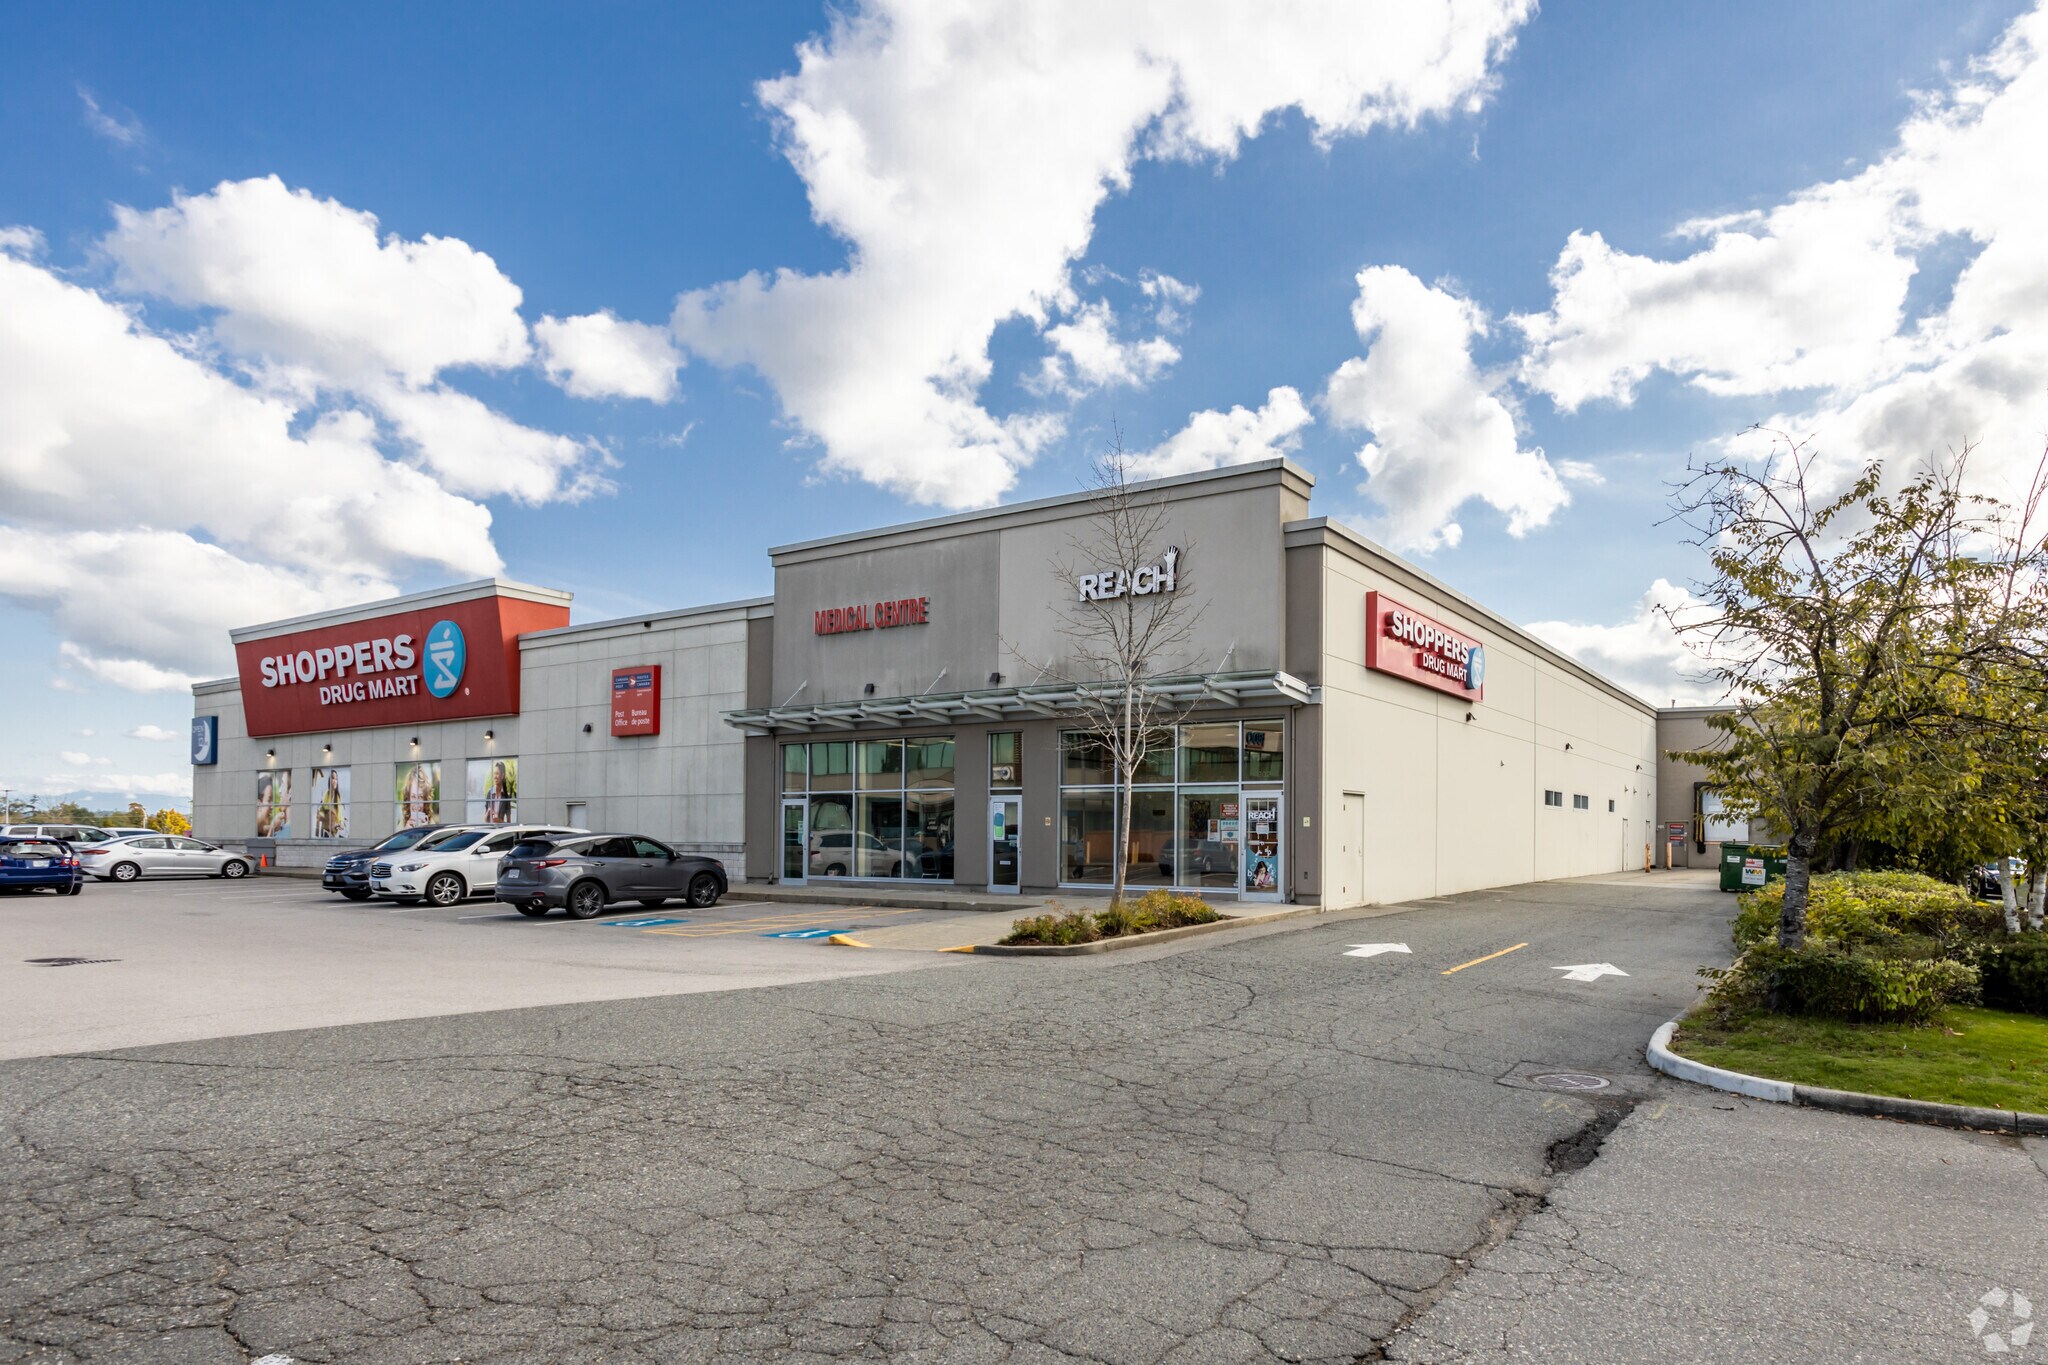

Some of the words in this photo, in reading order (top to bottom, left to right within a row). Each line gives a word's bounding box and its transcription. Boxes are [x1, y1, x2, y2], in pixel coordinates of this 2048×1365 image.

[1079, 546, 1176, 602] REACH
[814, 604, 870, 635] MEDICAL
[874, 596, 930, 630] CENTRE
[1391, 610, 1469, 665] SHOPPERS
[260, 634, 416, 688] SHOPPERS
[1423, 652, 1445, 673] DRUG
[1446, 662, 1467, 682] MART
[319, 682, 366, 706] DRUG
[368, 674, 419, 700] MART
[638, 718, 650, 726] poste
[1248, 807, 1275, 820] REACH
